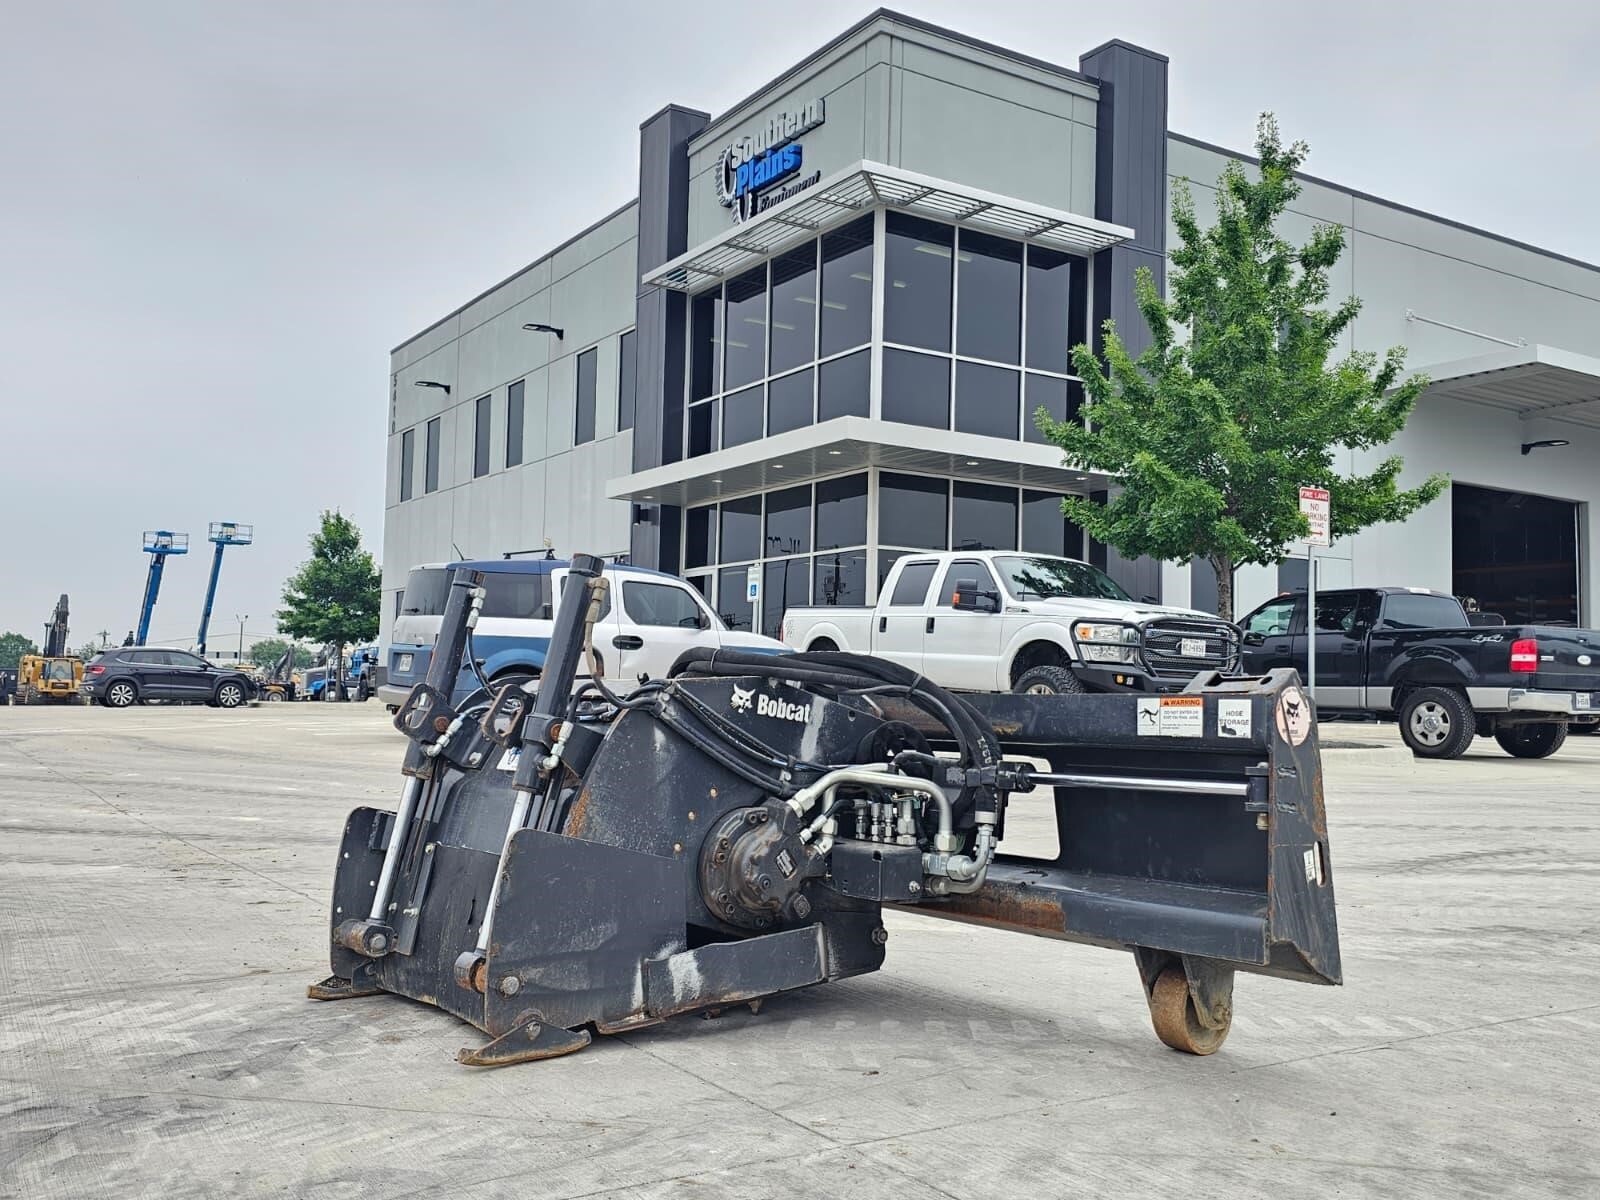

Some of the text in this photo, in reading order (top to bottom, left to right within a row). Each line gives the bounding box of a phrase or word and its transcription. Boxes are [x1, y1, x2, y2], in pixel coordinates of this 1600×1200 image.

[731, 98, 824, 169] Southern
[736, 144, 802, 199] Plains
[1304, 511, 1327, 522] ARKING
[1310, 503, 1319, 511] NO
[757, 694, 810, 723] Bobcat
